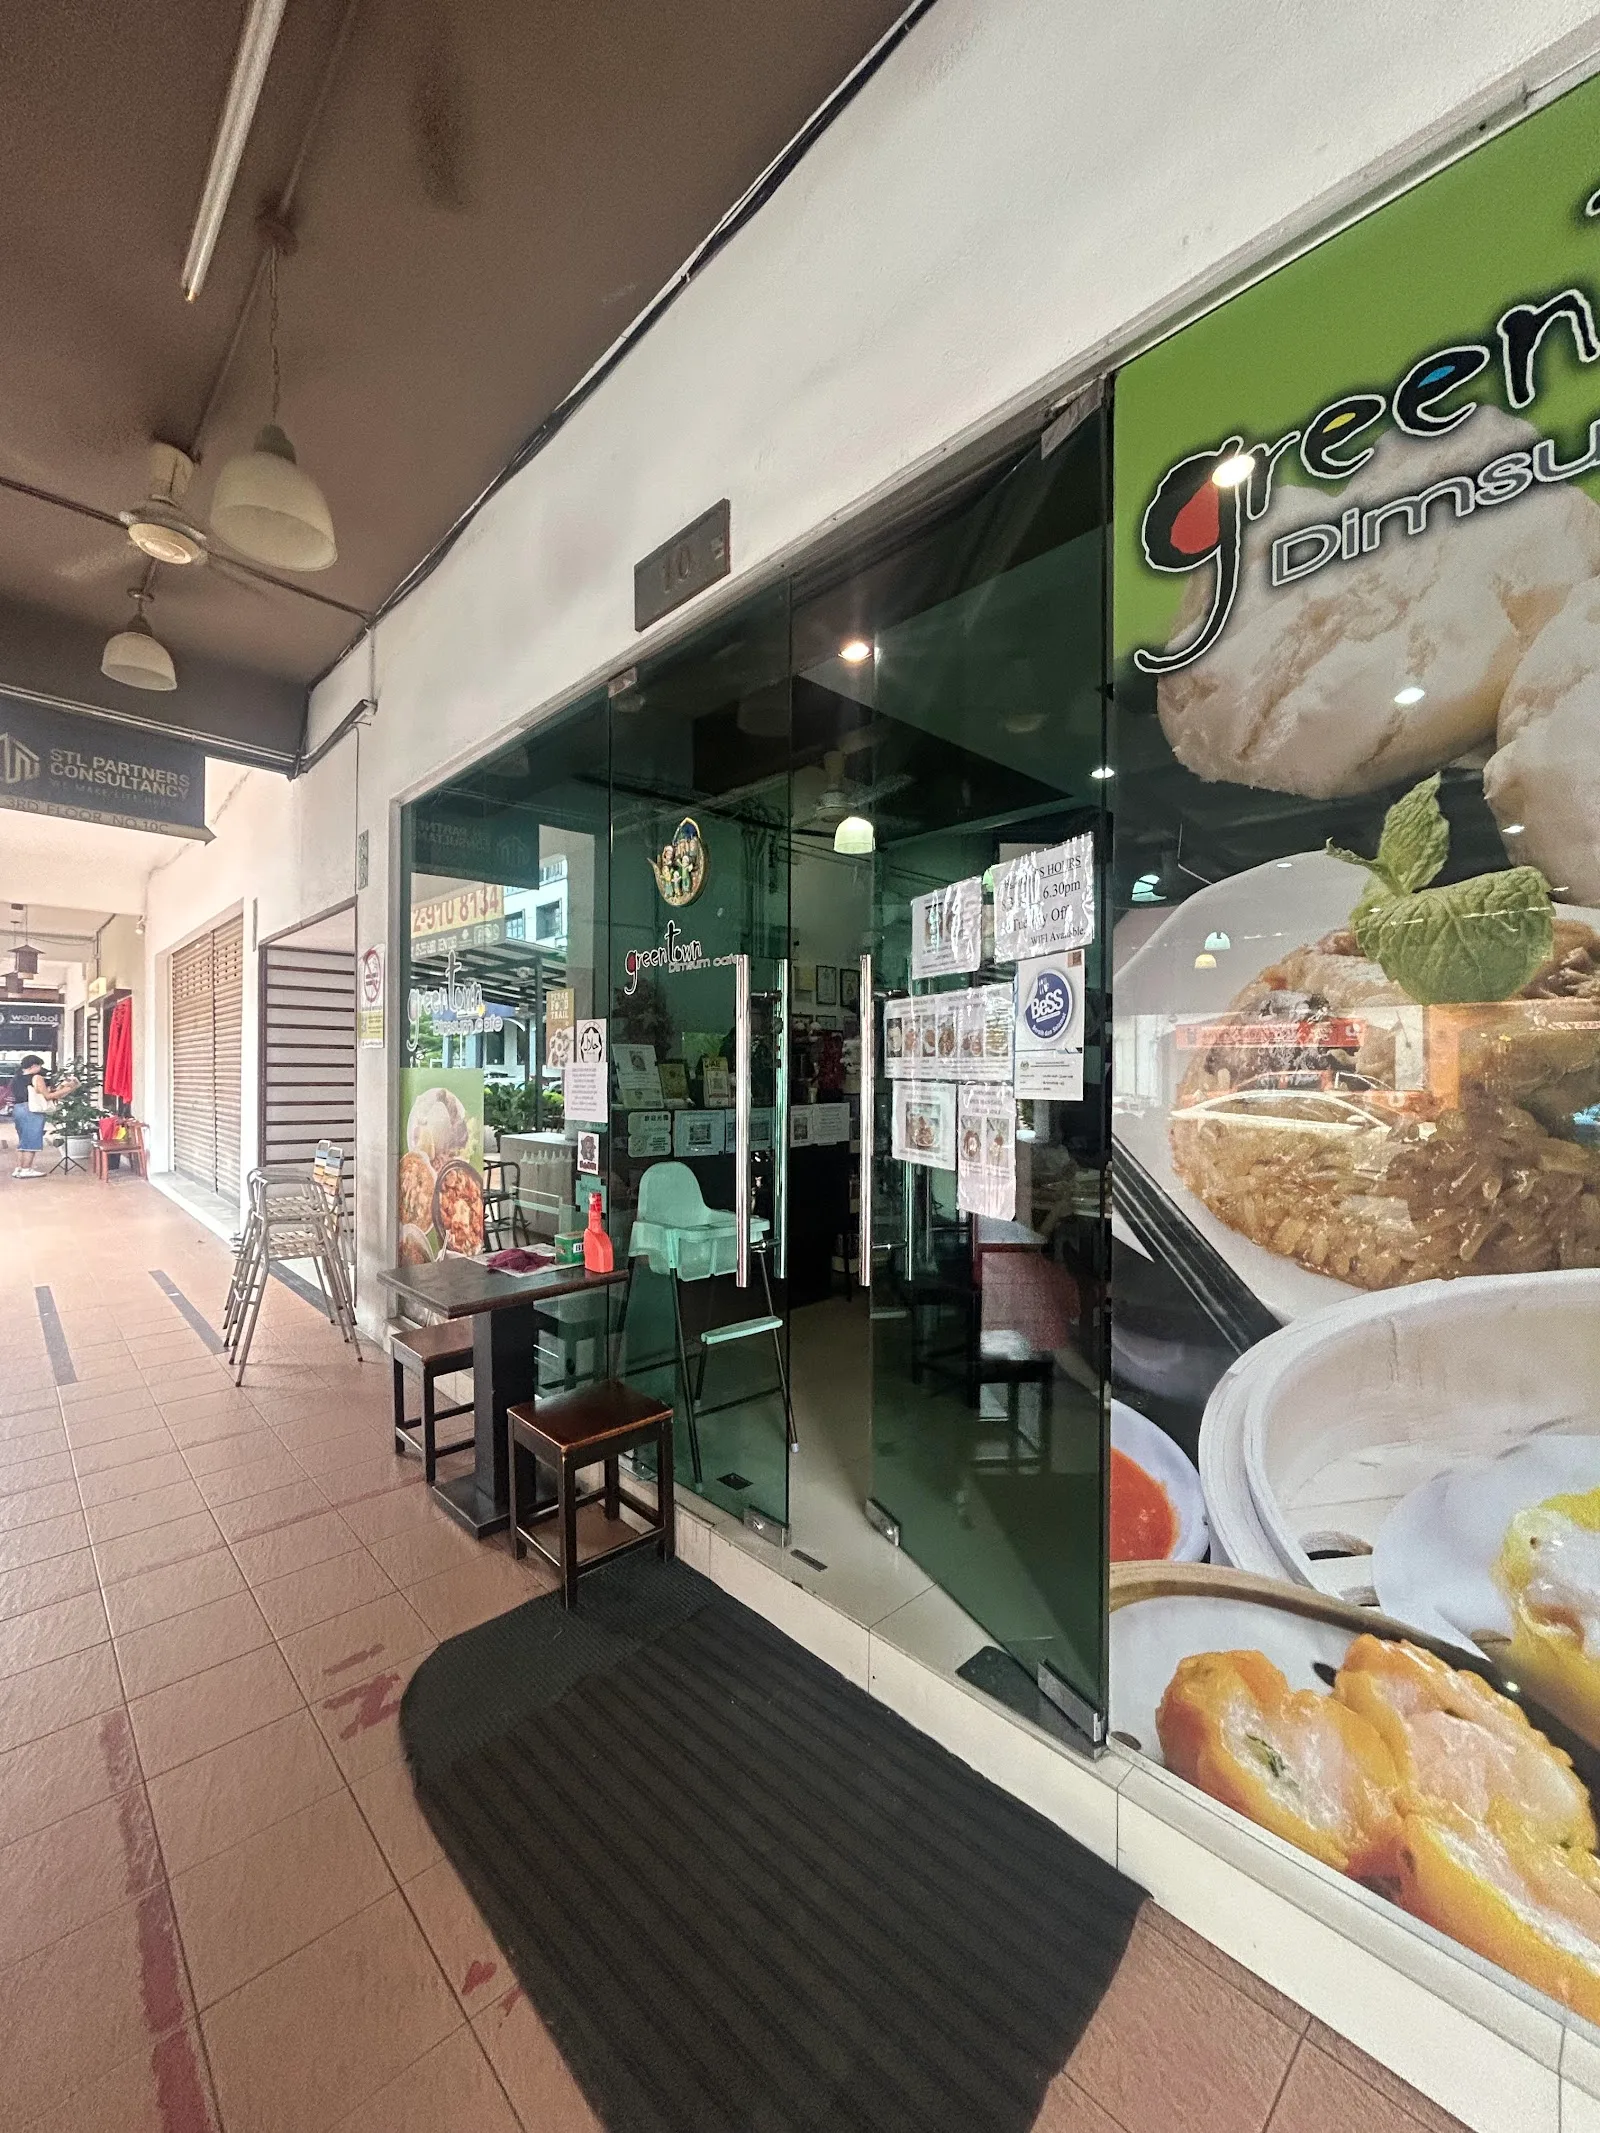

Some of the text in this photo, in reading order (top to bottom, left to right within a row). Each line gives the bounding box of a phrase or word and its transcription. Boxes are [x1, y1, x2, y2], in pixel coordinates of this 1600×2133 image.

[1133, 190, 1600, 675] green
[1271, 419, 1600, 588] Dimsu
[50, 749, 191, 787] STL PARTNERS
[50, 762, 190, 800] CONSULTANCY
[8, 798, 40, 813] 3RD
[46, 805, 102, 823] FLOOR
[1042, 880, 1081, 900] 6.30pm
[550, 1010, 569, 1020] TRAIL
[1030, 988, 1065, 1020] BeSS
